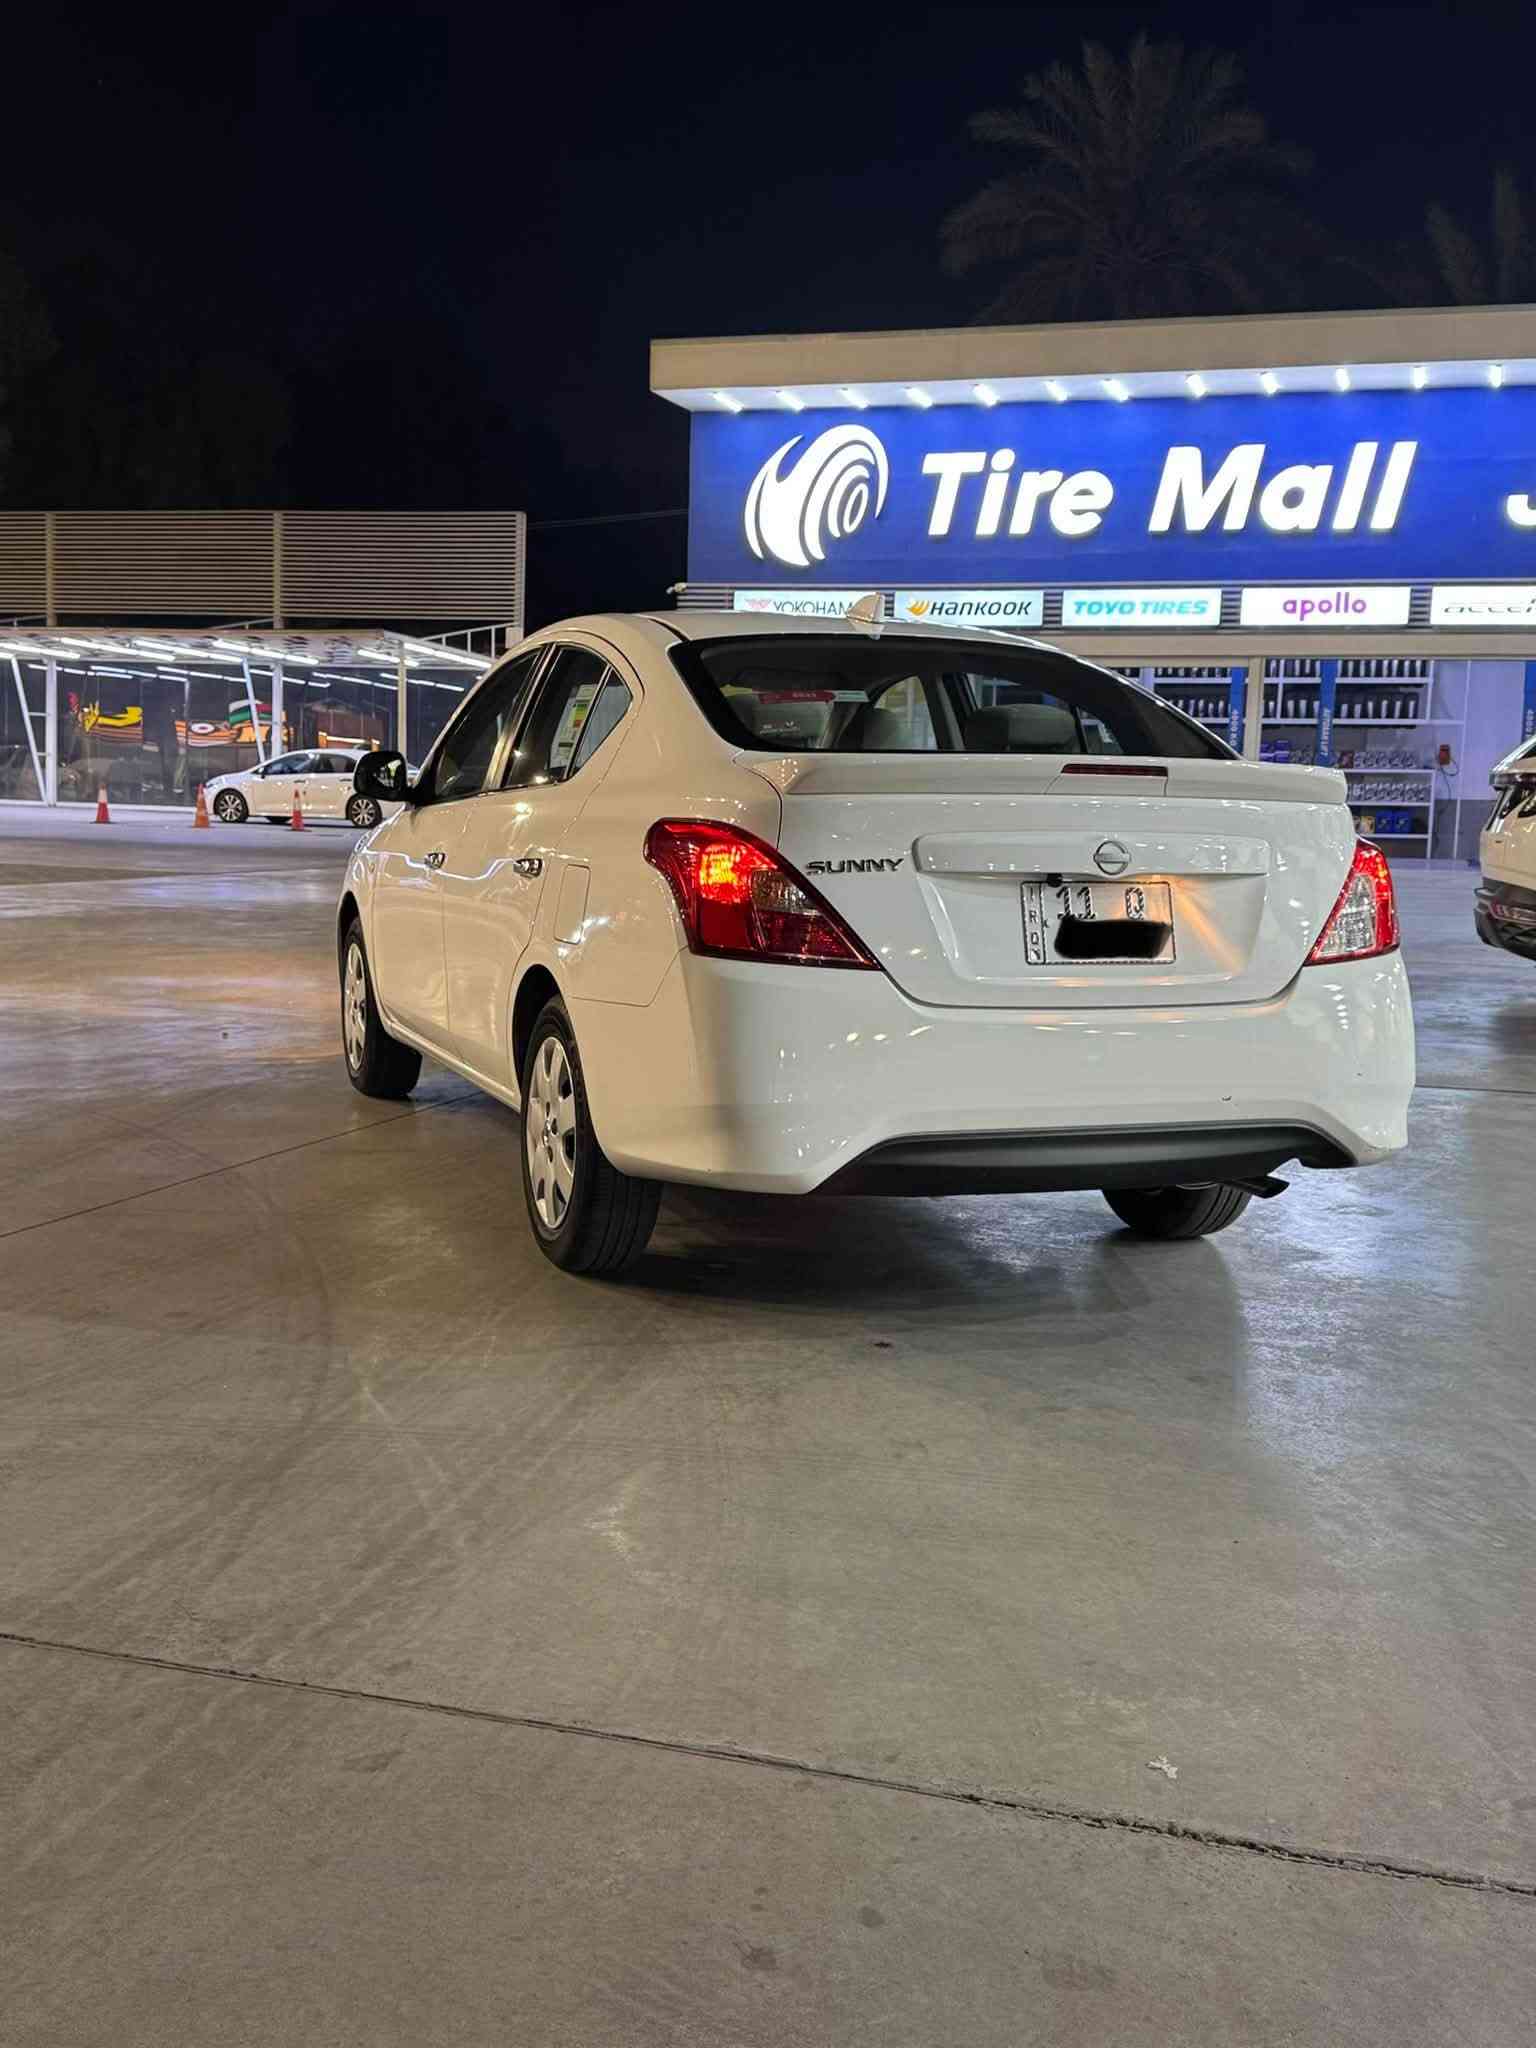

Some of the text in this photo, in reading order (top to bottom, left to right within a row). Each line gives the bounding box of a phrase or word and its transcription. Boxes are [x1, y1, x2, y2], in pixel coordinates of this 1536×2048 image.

[922, 440, 1418, 535] Tire Mall
[773, 600, 853, 616] YOKOHAM
[1073, 600, 1209, 615] TOYO TIRES
[1283, 592, 1367, 621] apollo
[805, 858, 904, 876] SUNNY
[1056, 886, 1096, 919] 11
